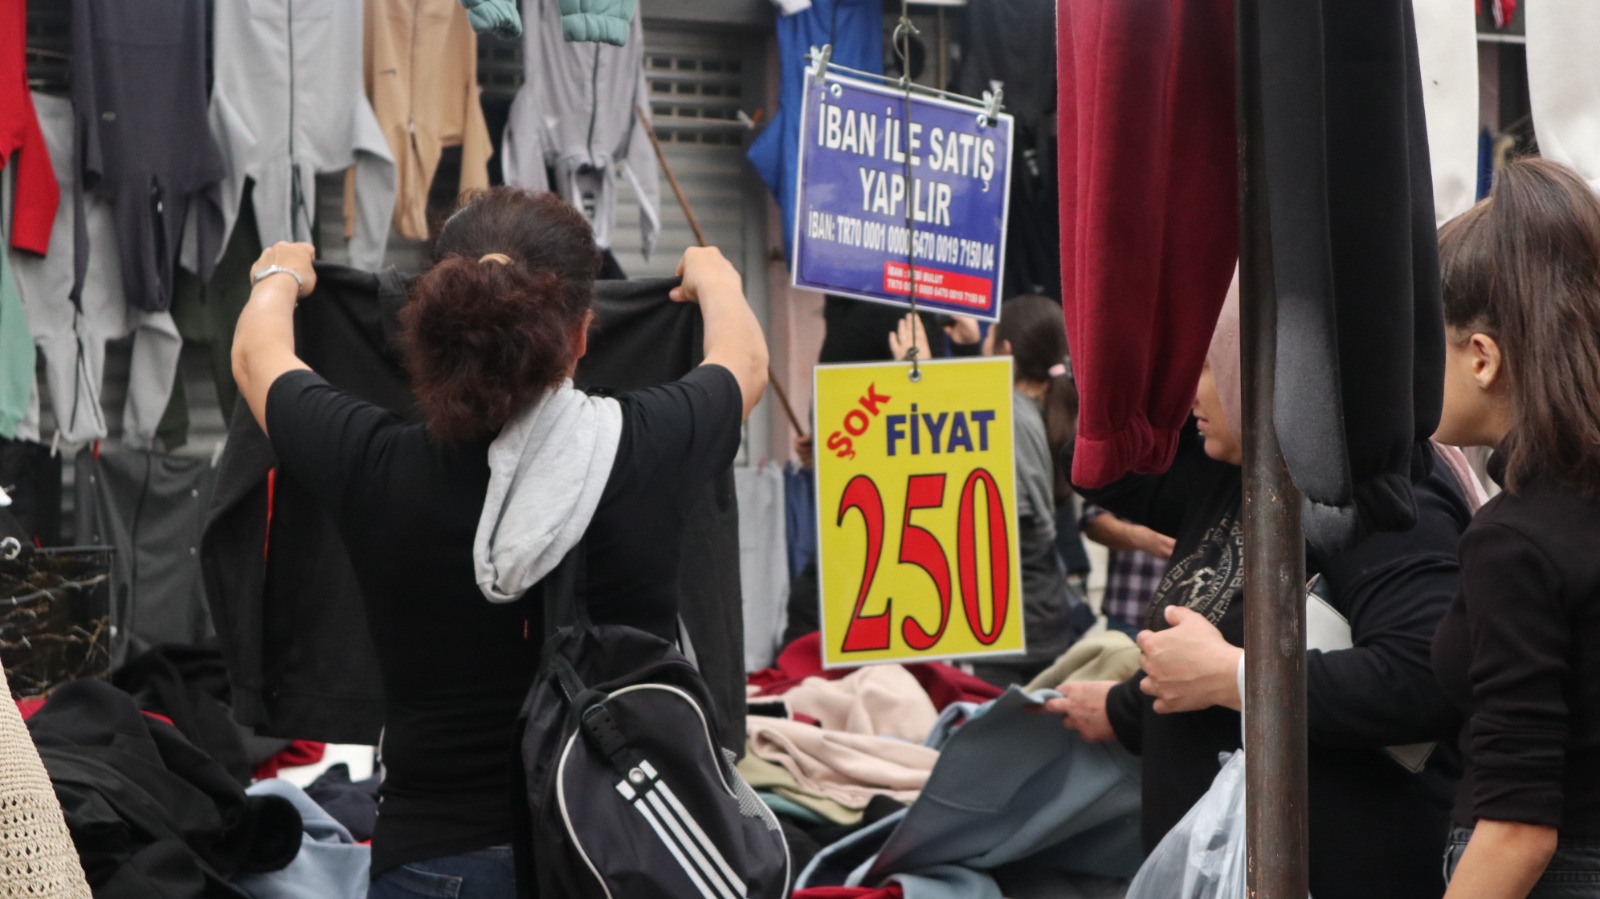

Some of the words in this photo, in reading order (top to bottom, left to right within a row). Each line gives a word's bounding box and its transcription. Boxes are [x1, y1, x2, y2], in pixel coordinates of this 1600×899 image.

[818, 92, 876, 157] İBAN
[884, 107, 922, 166] İLE
[929, 127, 995, 192] SATIŞ
[808, 204, 835, 241] İBAN:
[837, 215, 862, 247] TR70
[863, 220, 886, 251] 0001
[913, 230, 935, 261] 6470
[936, 234, 959, 265] 0019
[960, 238, 982, 269] 7150
[982, 243, 995, 271] 04
[826, 382, 892, 461] ŞOK
[886, 403, 995, 456] FİYAT
[837, 467, 1010, 653] 250
